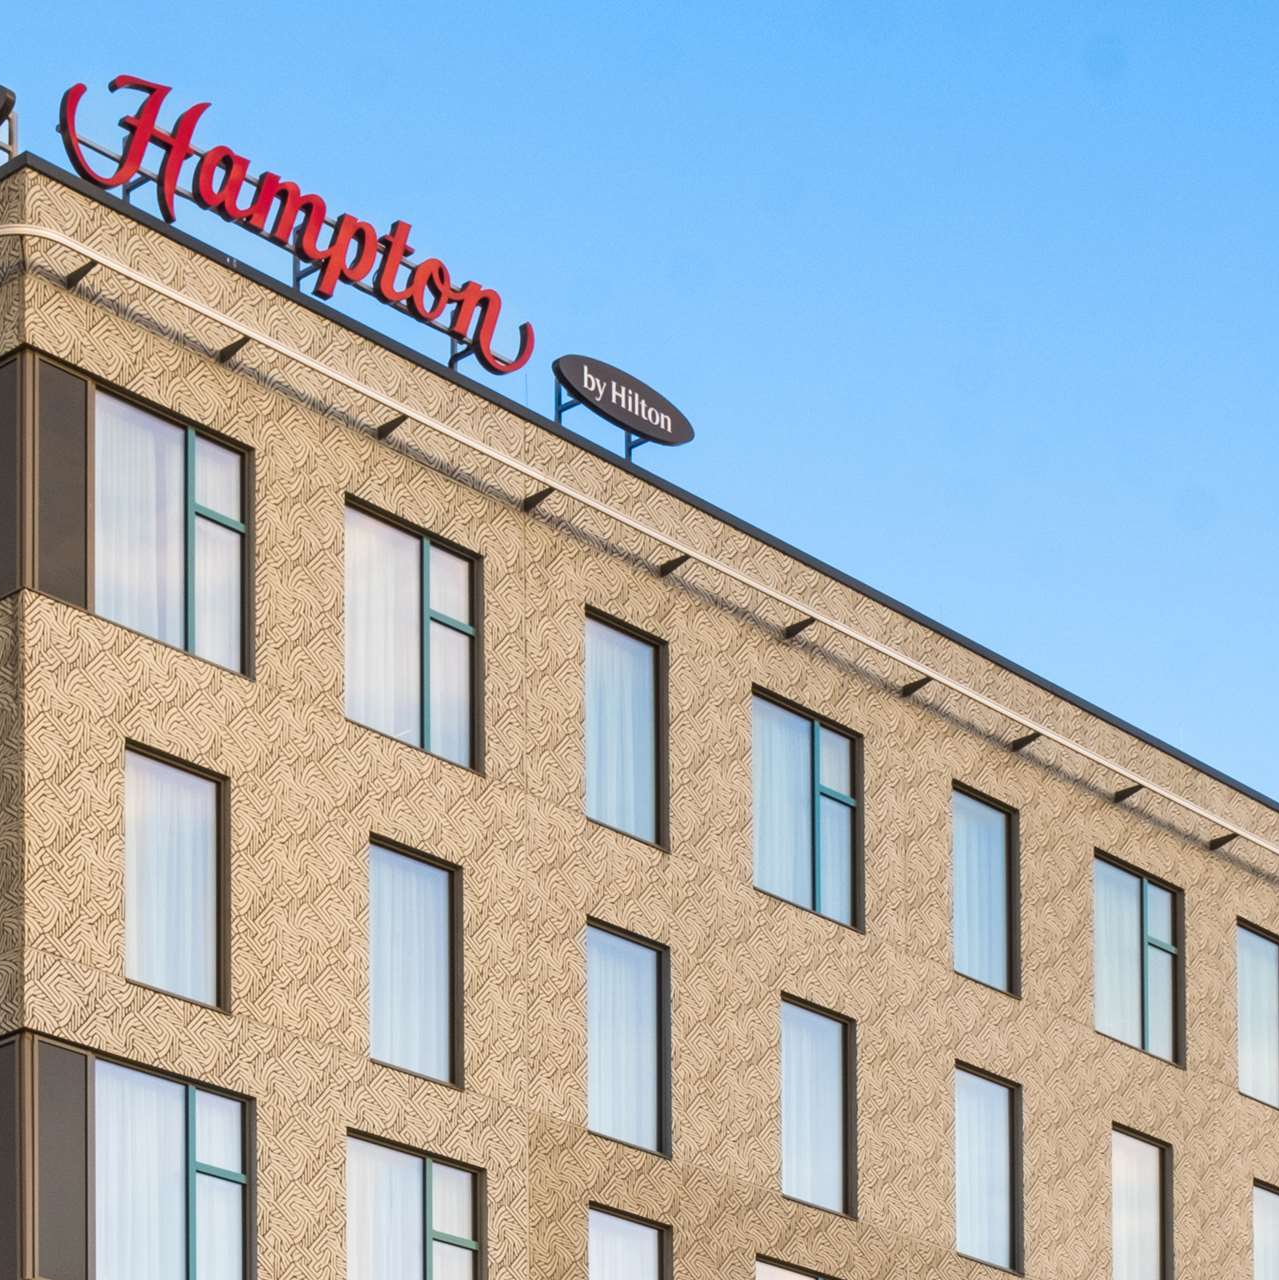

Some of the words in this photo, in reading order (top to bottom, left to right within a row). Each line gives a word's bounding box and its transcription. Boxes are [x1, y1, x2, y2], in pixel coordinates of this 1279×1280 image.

[59, 74, 535, 376] Hampton
[582, 364, 607, 402] by
[610, 380, 673, 434] Hilton
